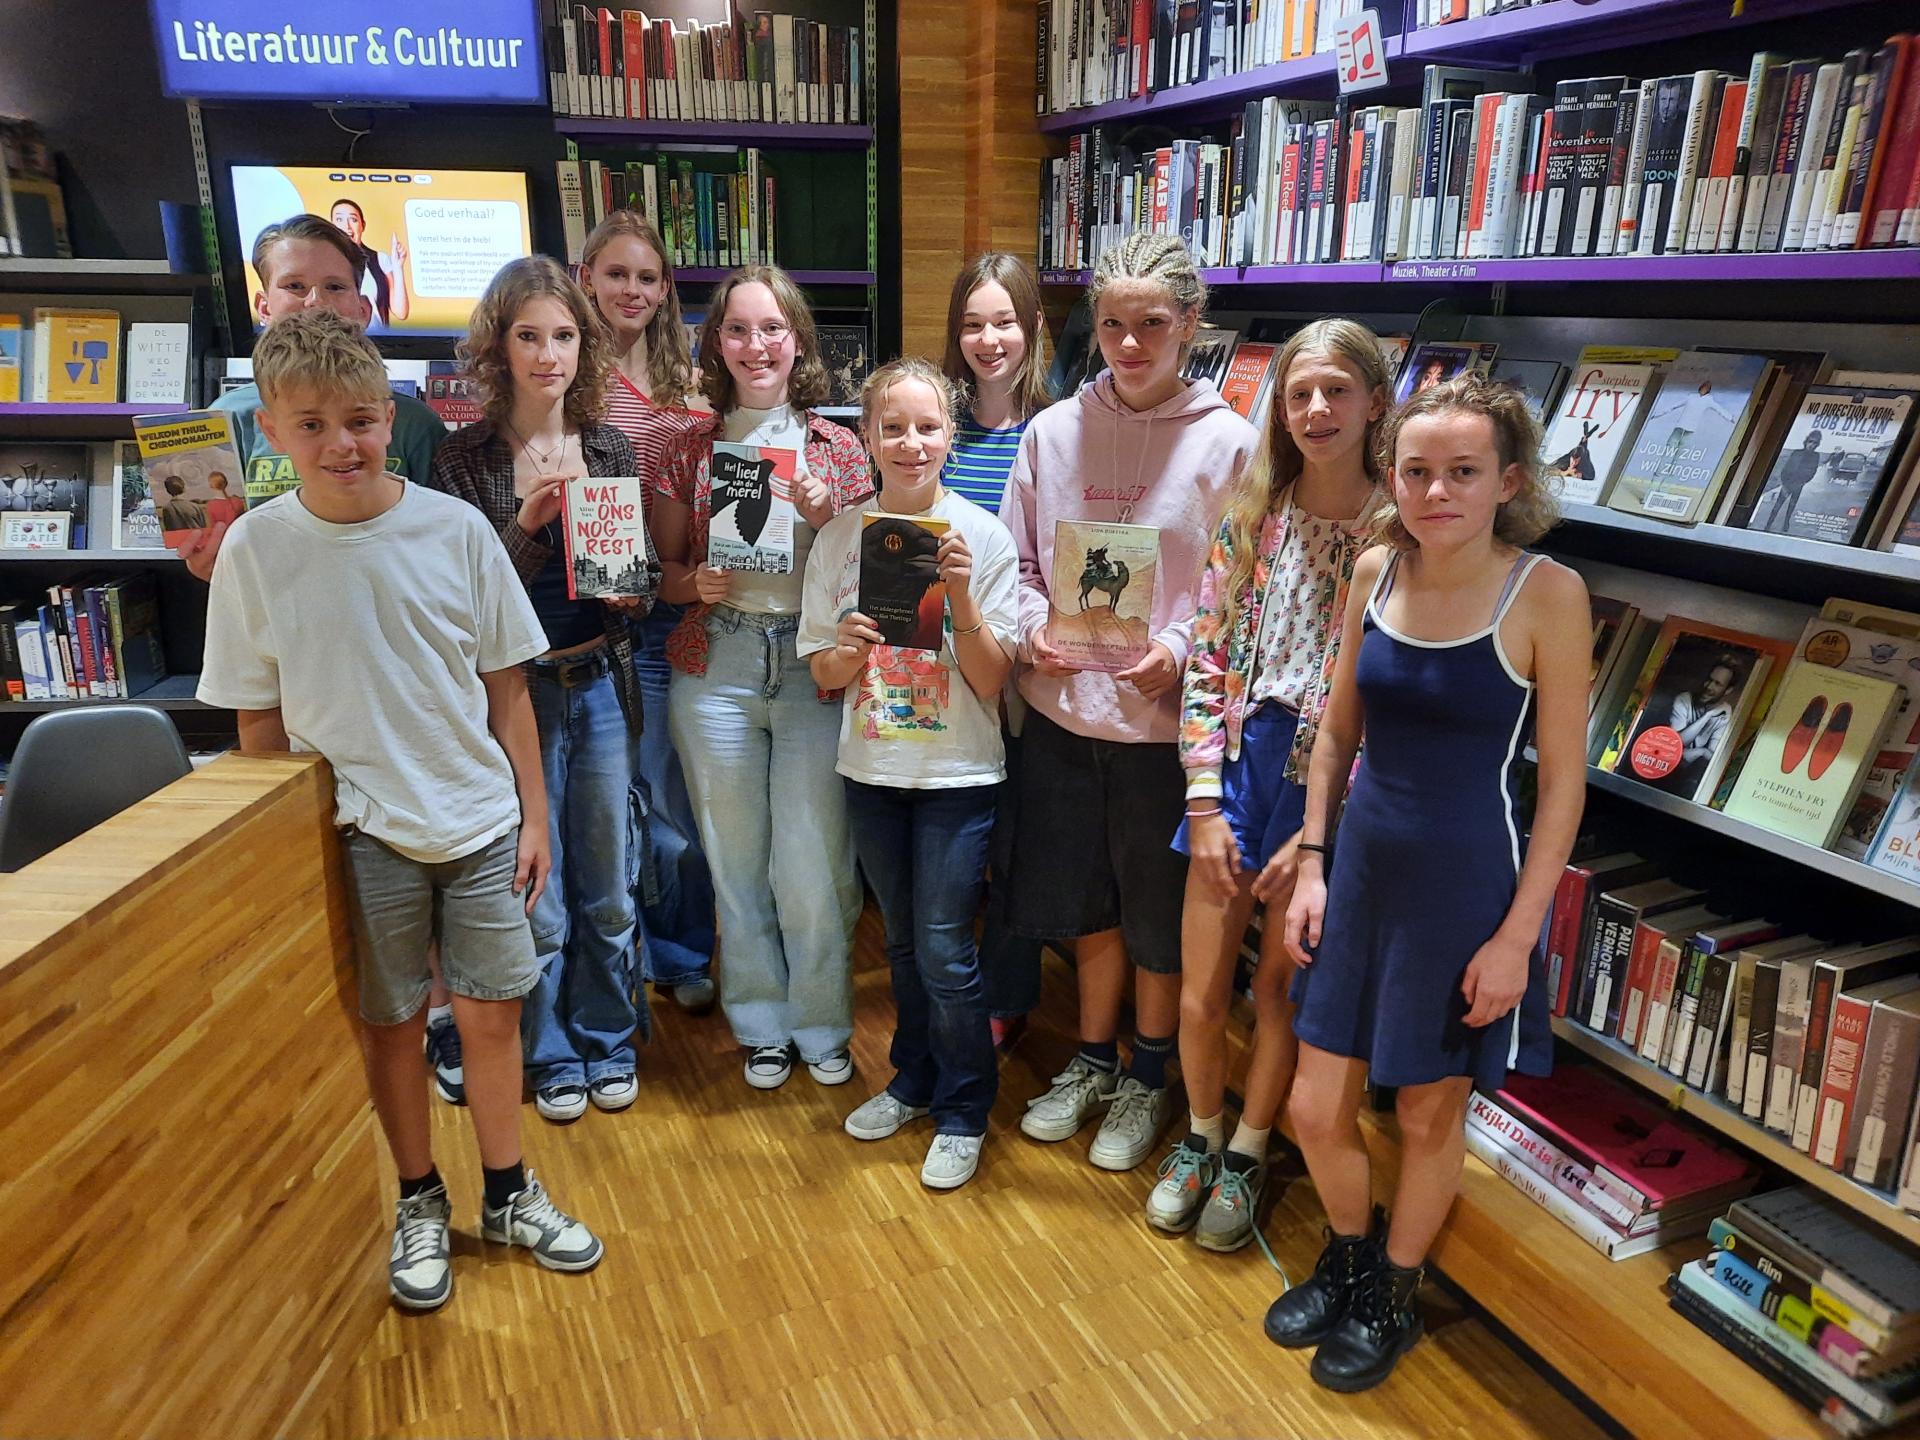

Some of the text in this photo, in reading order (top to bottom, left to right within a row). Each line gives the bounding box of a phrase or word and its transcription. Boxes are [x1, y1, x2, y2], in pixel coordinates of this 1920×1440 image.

[172, 20, 359, 65] Literatuur
[364, 26, 389, 66] &
[393, 27, 523, 68] Cultuur
[1037, 49, 1045, 82] REED
[1616, 102, 1626, 135] HERMANS
[1624, 102, 1635, 133] MAURICE
[1361, 138, 1374, 166] Sting
[1431, 109, 1443, 183] MATTHEW PERRY
[1503, 106, 1519, 178] KARIN BLOEMEN
[1786, 137, 1799, 161] VEEN
[1092, 129, 1101, 207] MICHAEL JACKSON
[1168, 154, 1178, 190] GEORGE
[1284, 152, 1296, 178] Lou
[1312, 137, 1327, 192] ROLLING
[1549, 160, 1574, 168] YOUP
[1580, 158, 1606, 166] YOUP
[1327, 147, 1338, 203] SPRINGSTEEN
[1549, 172, 1568, 180] HEK
[1581, 171, 1600, 179] HEK
[1644, 169, 1678, 181] TOON
[1156, 165, 1169, 208] FAB
[414, 207, 496, 219] Goed verhaal?
[1392, 264, 1477, 278] Muziek, Theater & Film
[154, 329, 167, 337] DE
[137, 342, 182, 353] WITTE
[135, 380, 181, 388] EDMUND
[1601, 374, 1640, 388] stephen
[1565, 369, 1640, 439] fry
[1806, 402, 1819, 415] NO
[1820, 403, 1869, 420] DIRECTION
[140, 426, 180, 442] WELKOM
[1811, 415, 1889, 435] BOB DYLAN
[148, 430, 226, 451] CHRONONAUTEN
[1639, 441, 1707, 462] Jouw ziel
[724, 462, 761, 481] Het lied
[1640, 459, 1711, 481] wil zingen
[583, 486, 618, 503] WAT
[726, 484, 763, 500] merel
[744, 480, 754, 488] de
[598, 504, 635, 520] ONS
[577, 520, 618, 538] NOG
[585, 538, 634, 556] REST
[1635, 752, 1656, 768] DIGGY
[1757, 777, 1825, 808] STEPHEN FRY
[1751, 790, 1768, 802] Een
[1805, 806, 1822, 821] tijd
[1888, 836, 1920, 862] BL
[1615, 924, 1633, 957] PAUL
[1472, 1100, 1553, 1165] Kijk! Dat is
[1756, 1256, 1784, 1284] Film
[1722, 1266, 1754, 1297] Kill
